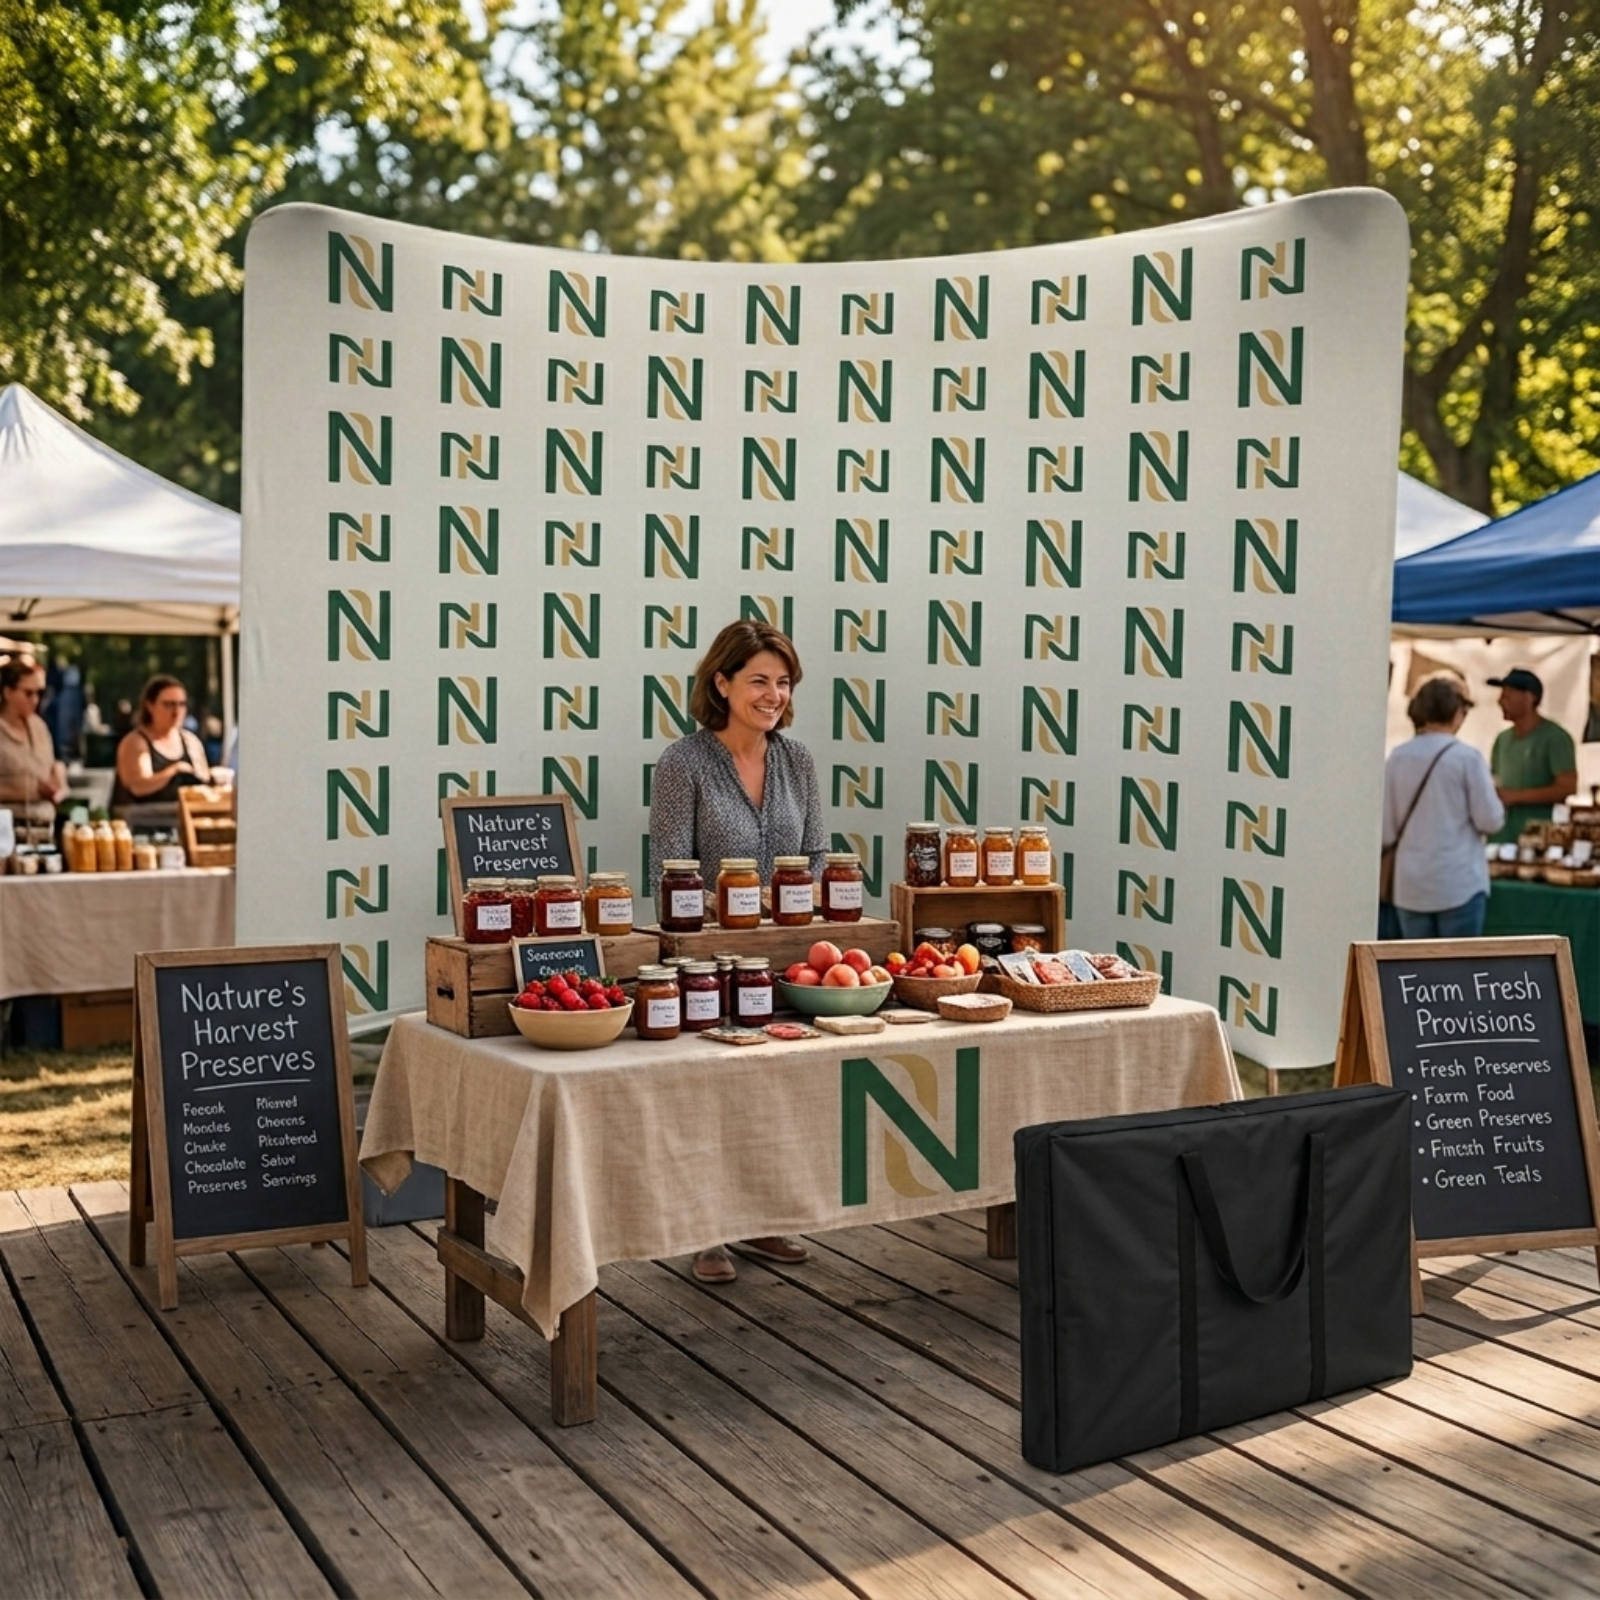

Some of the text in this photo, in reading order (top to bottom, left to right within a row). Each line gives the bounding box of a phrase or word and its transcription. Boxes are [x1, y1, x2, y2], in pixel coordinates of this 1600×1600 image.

[467, 812, 552, 834] Nature's
[477, 833, 548, 853] Harvest
[472, 854, 559, 873] Preserves
[180, 979, 307, 1014] Nature's
[1397, 970, 1542, 1005] Farm Fresh
[193, 1013, 299, 1046] Harvest
[1415, 1008, 1536, 1037] Provisions
[180, 1050, 316, 1080] Preserves
[1419, 1055, 1552, 1079] Fresh Preserves
[1423, 1082, 1515, 1105] Farm Food
[841, 1047, 980, 1207] N
[1425, 1108, 1553, 1131] Green Preserves
[1492, 1134, 1545, 1154] Fruits
[1434, 1168, 1487, 1189] Green
